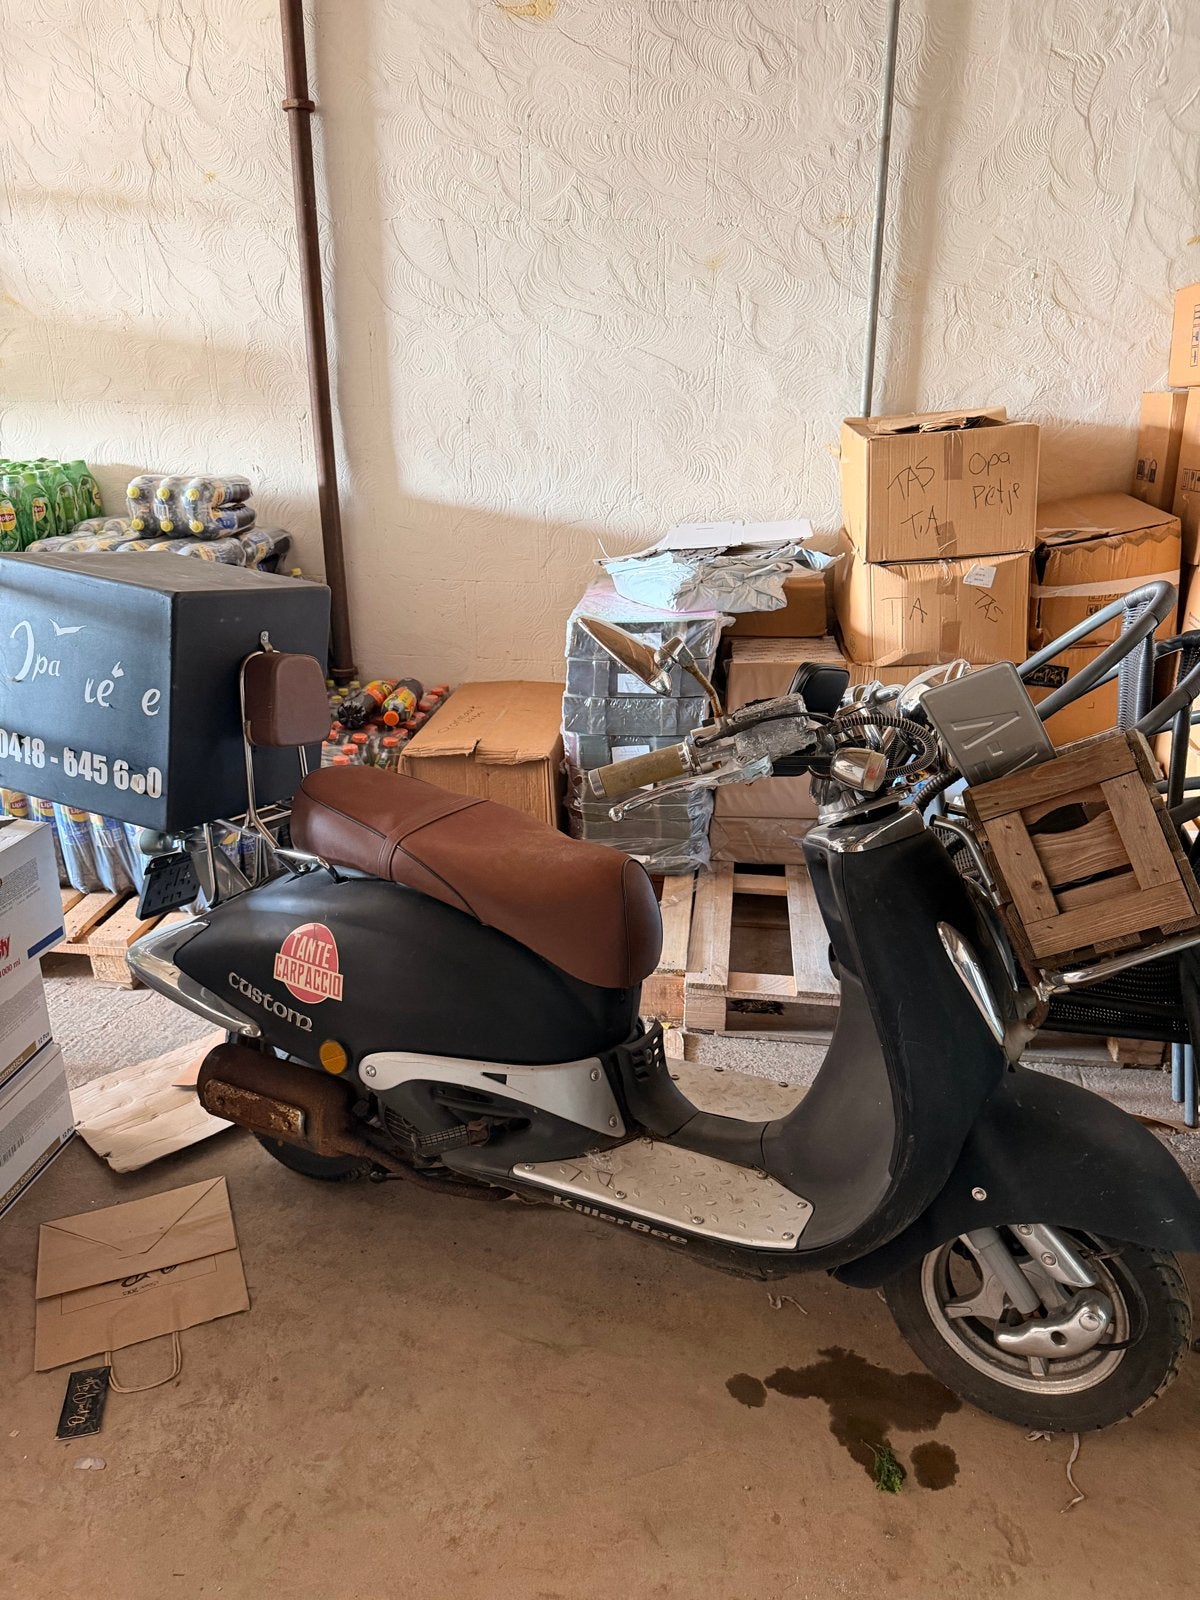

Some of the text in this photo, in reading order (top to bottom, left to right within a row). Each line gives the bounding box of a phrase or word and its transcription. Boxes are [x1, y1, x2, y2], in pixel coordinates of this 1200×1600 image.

[887, 456, 935, 500] TAS
[968, 452, 1011, 476] Opa
[63, 747, 109, 785] 645
[290, 932, 334, 968] TANTE
[275, 956, 341, 997] CARPACCIO
[228, 972, 313, 1032] custom
